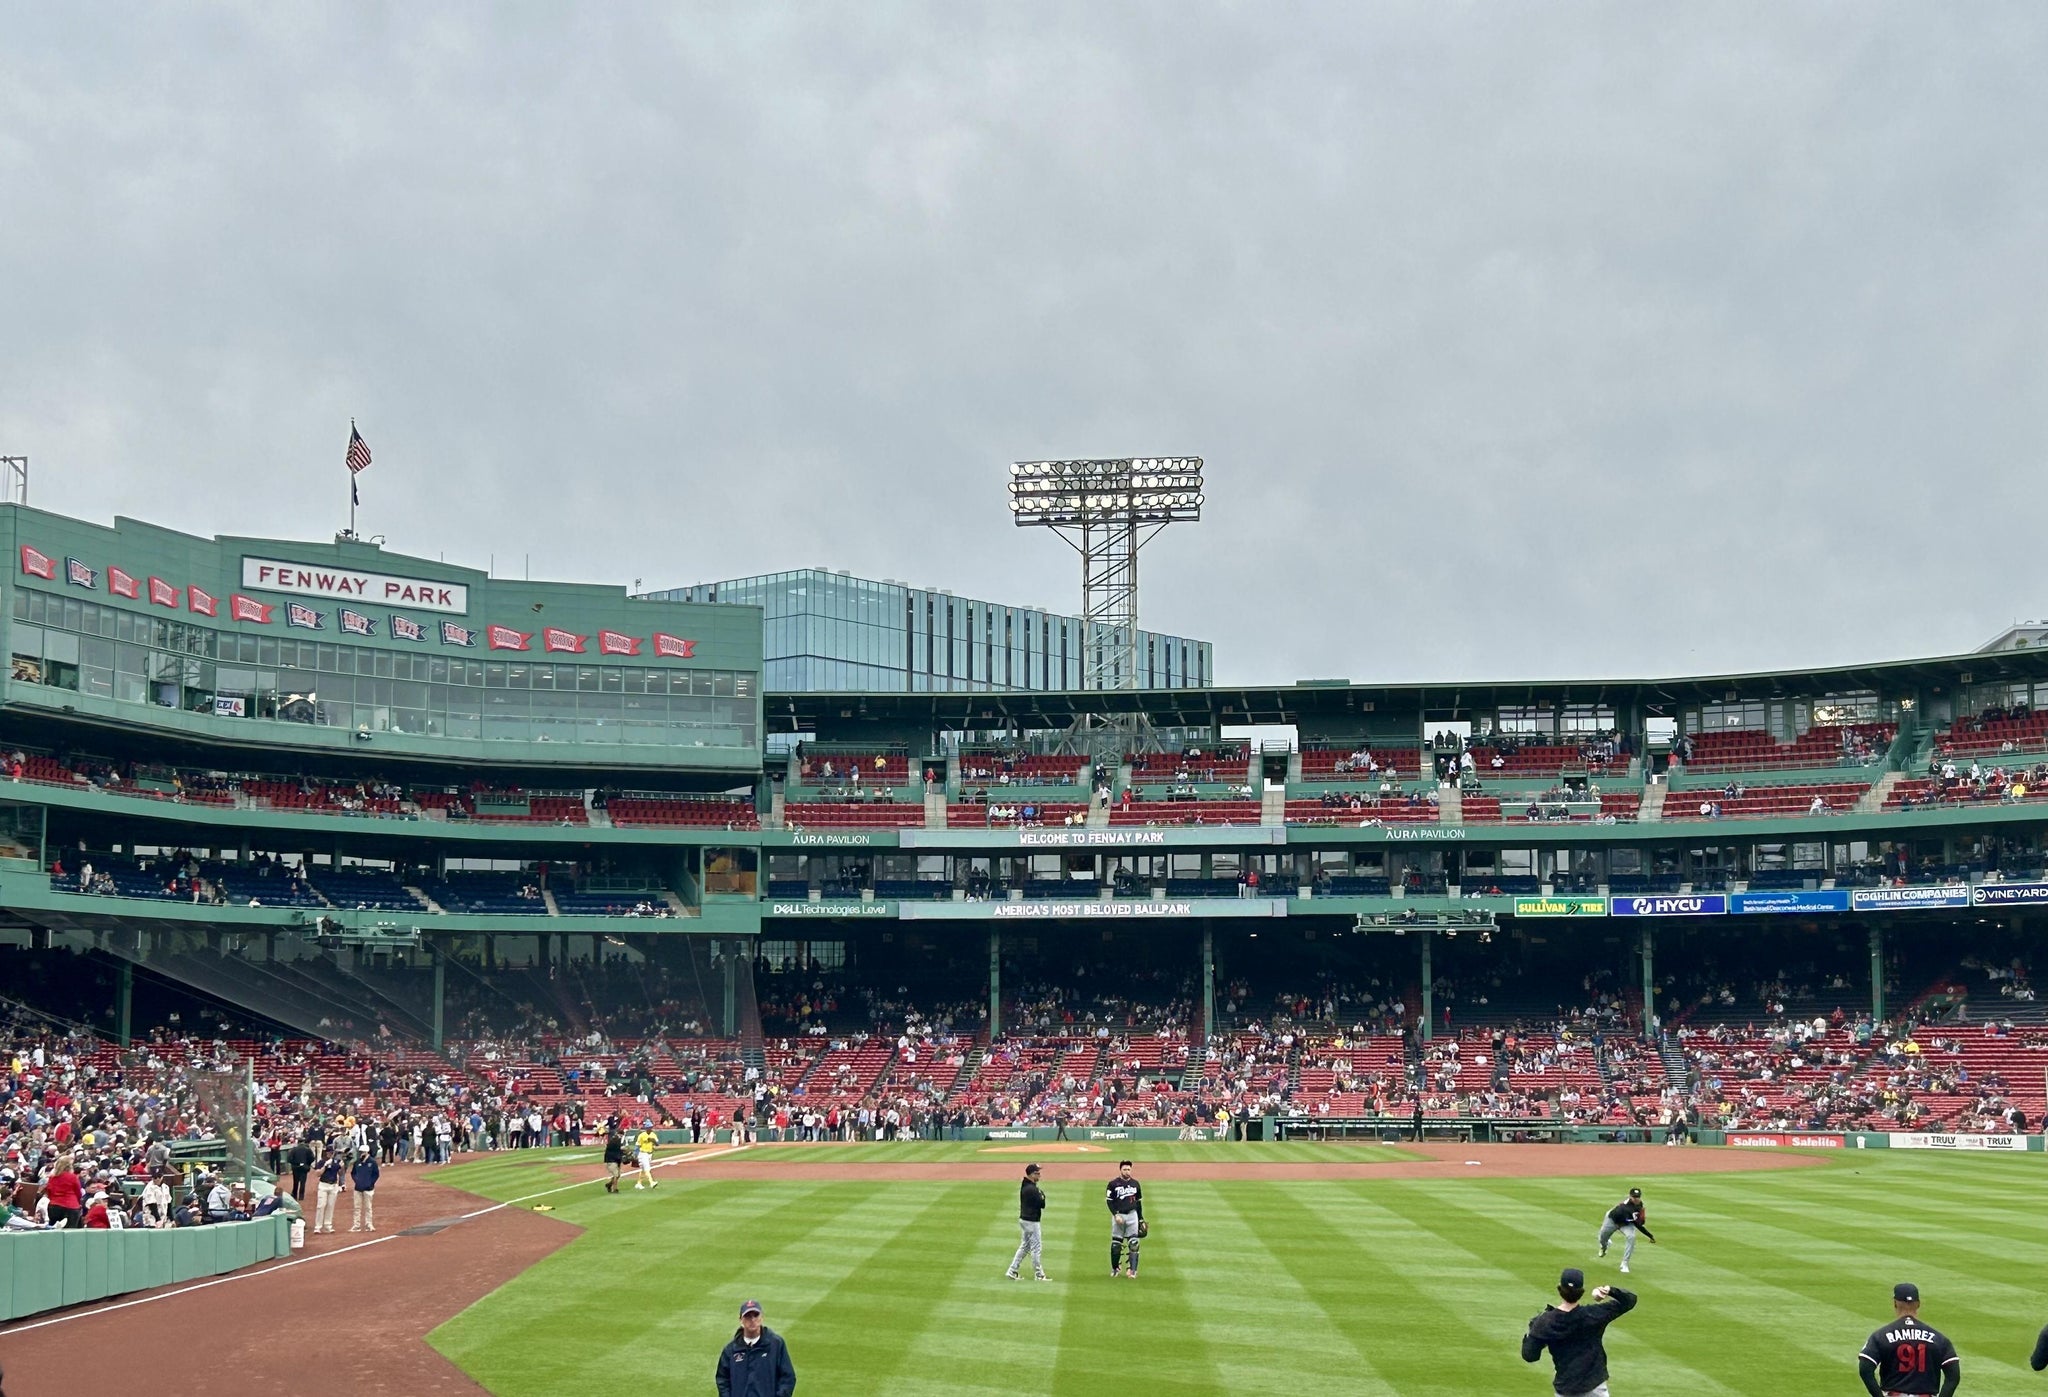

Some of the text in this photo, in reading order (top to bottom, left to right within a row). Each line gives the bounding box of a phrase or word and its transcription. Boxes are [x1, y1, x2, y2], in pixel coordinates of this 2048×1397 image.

[259, 566, 452, 605] FENWAY PARK
[826, 835, 870, 844] PAVILION
[1020, 832, 1164, 844] WELCOME TO FENWAY PARK
[1420, 829, 1465, 839] PAVILION
[1855, 888, 1967, 902] COGHLIN COMPANIES
[1986, 888, 2048, 898] VINEYARD
[773, 904, 886, 917] DELL Technologies Level
[993, 903, 1190, 916] AMERICA'S MOST BELOVED BALLPARK
[1518, 901, 1604, 913] SULLIVAN TIRE
[1655, 899, 1701, 911] HYCU
[1733, 1136, 1837, 1147] Safelite Safelite
[1931, 1136, 1956, 1144] TRULY
[1987, 1137, 2012, 1145] TRULY
[1885, 1328, 1936, 1343] RAMIREZ
[1897, 1343, 1927, 1373] 91
